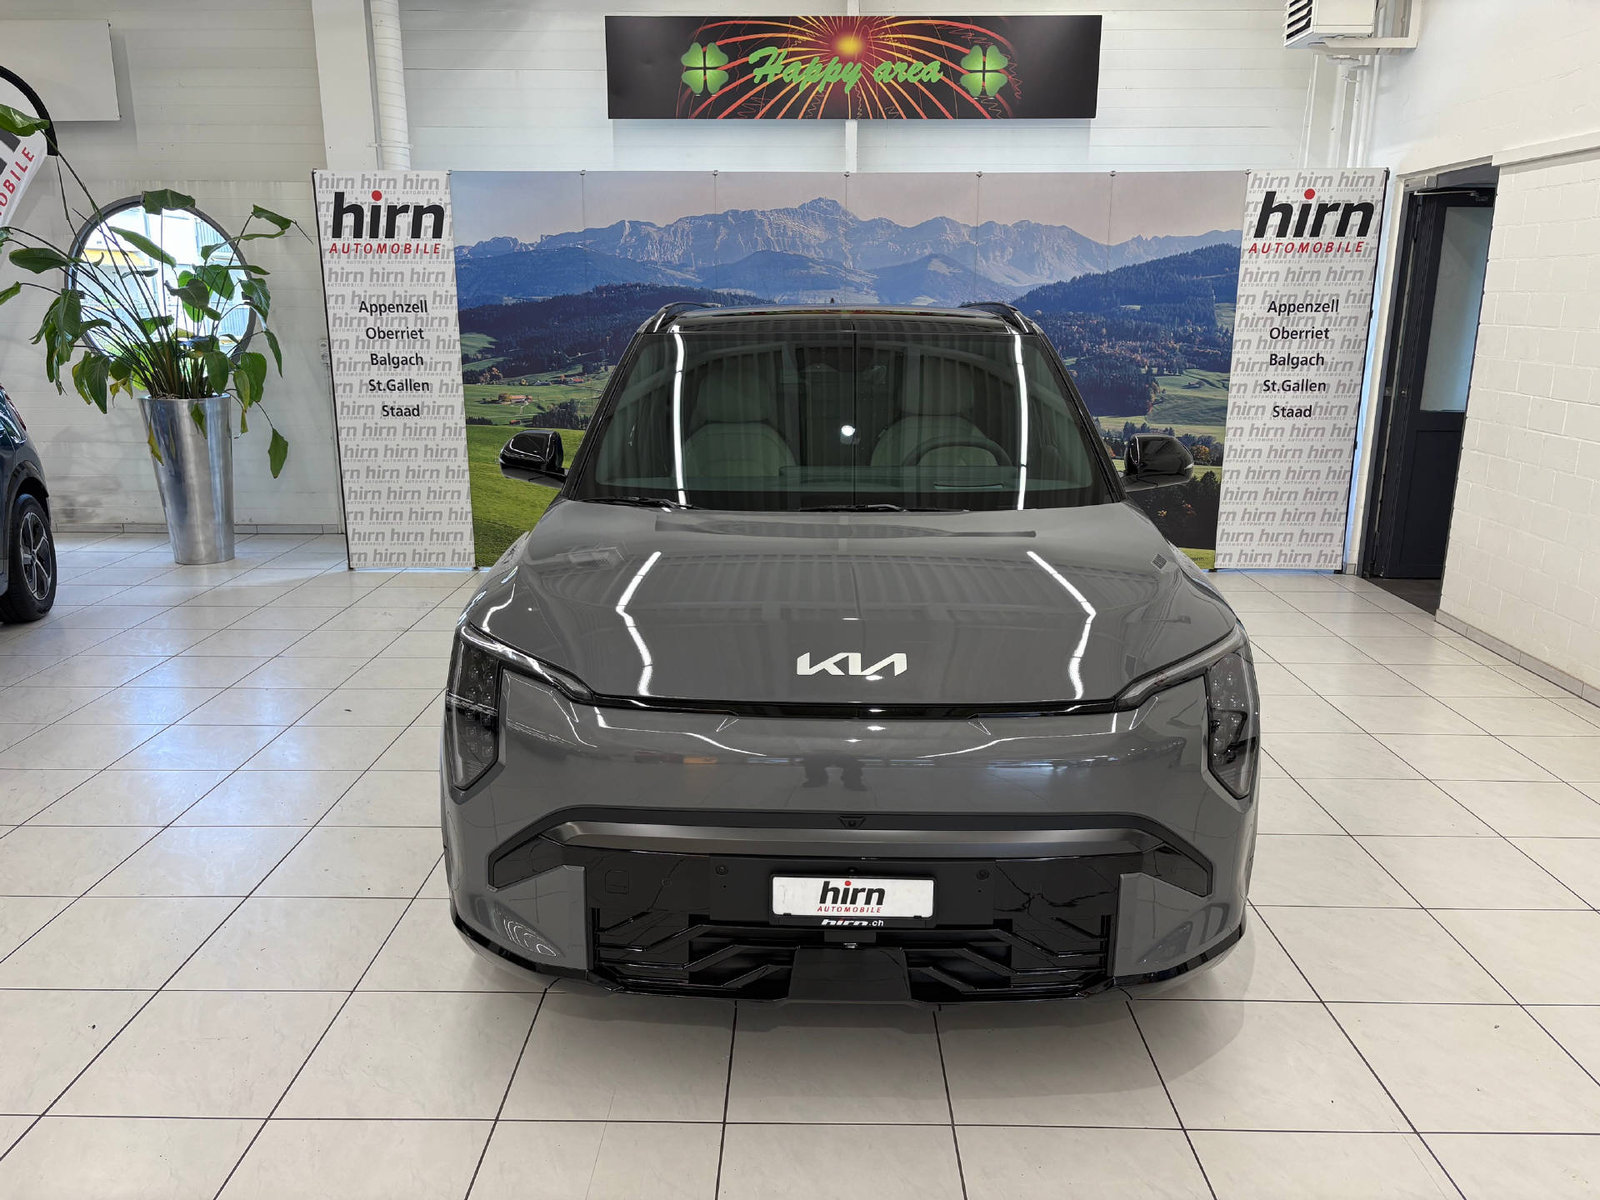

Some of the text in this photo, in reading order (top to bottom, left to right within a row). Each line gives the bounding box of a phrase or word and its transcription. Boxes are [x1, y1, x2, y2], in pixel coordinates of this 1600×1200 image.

[748, 47, 944, 93] Happy area
[318, 173, 439, 189] hirn hirn hirn
[1251, 171, 1375, 188] hirn hirn hirn
[332, 190, 444, 239] hirn
[1253, 188, 1375, 239] hirn
[329, 243, 441, 254] AUTOMOBILE
[1248, 241, 1365, 254] AUTOMOBILE
[327, 267, 446, 282] hirn hirn hirn
[1241, 266, 1363, 282] hirn hirn hirn
[359, 300, 428, 316] Appenzell
[1267, 299, 1339, 316] Appenzell
[332, 312, 449, 327] hirn hirn hirn
[1237, 311, 1358, 328] hirn hirn hirn
[366, 327, 424, 340] Oberriet
[1269, 327, 1330, 340] Oberriet
[370, 353, 424, 368] Balgach
[1269, 353, 1325, 369] Balgach
[368, 379, 430, 392] St.Gallen
[1263, 379, 1326, 392] St.Gallen
[340, 401, 375, 415] hirn
[382, 404, 420, 417] Staad
[1229, 401, 1266, 416] hirn
[1272, 405, 1312, 418] Staad
[362, 422, 397, 437] hirn
[402, 422, 437, 436] hirn
[1248, 422, 1284, 437] hirn
[1289, 423, 1325, 438] hirn
[343, 444, 458, 458] hirn hirn hirn
[1226, 444, 1343, 459] hirn hirn hirn
[365, 465, 400, 479] hirn
[405, 465, 440, 479] hirn
[1244, 465, 1280, 480] hirn
[1284, 465, 1321, 480] hirn
[347, 486, 461, 500] hirn hirn hirn
[1222, 486, 1338, 501] hirn hirn hirn
[369, 507, 403, 521] hirn
[408, 507, 443, 521] hirn
[1240, 507, 1276, 522] hirn
[1280, 507, 1316, 522] hirn
[351, 527, 464, 542] hirn hirn hirn
[1218, 528, 1334, 543] hirn hirn hirn
[372, 548, 407, 562] hirn
[411, 548, 446, 562] hirn
[1237, 549, 1272, 563] hirn
[1276, 549, 1312, 563] hirn
[796, 652, 908, 676] KIA
[819, 880, 886, 906] hirn
